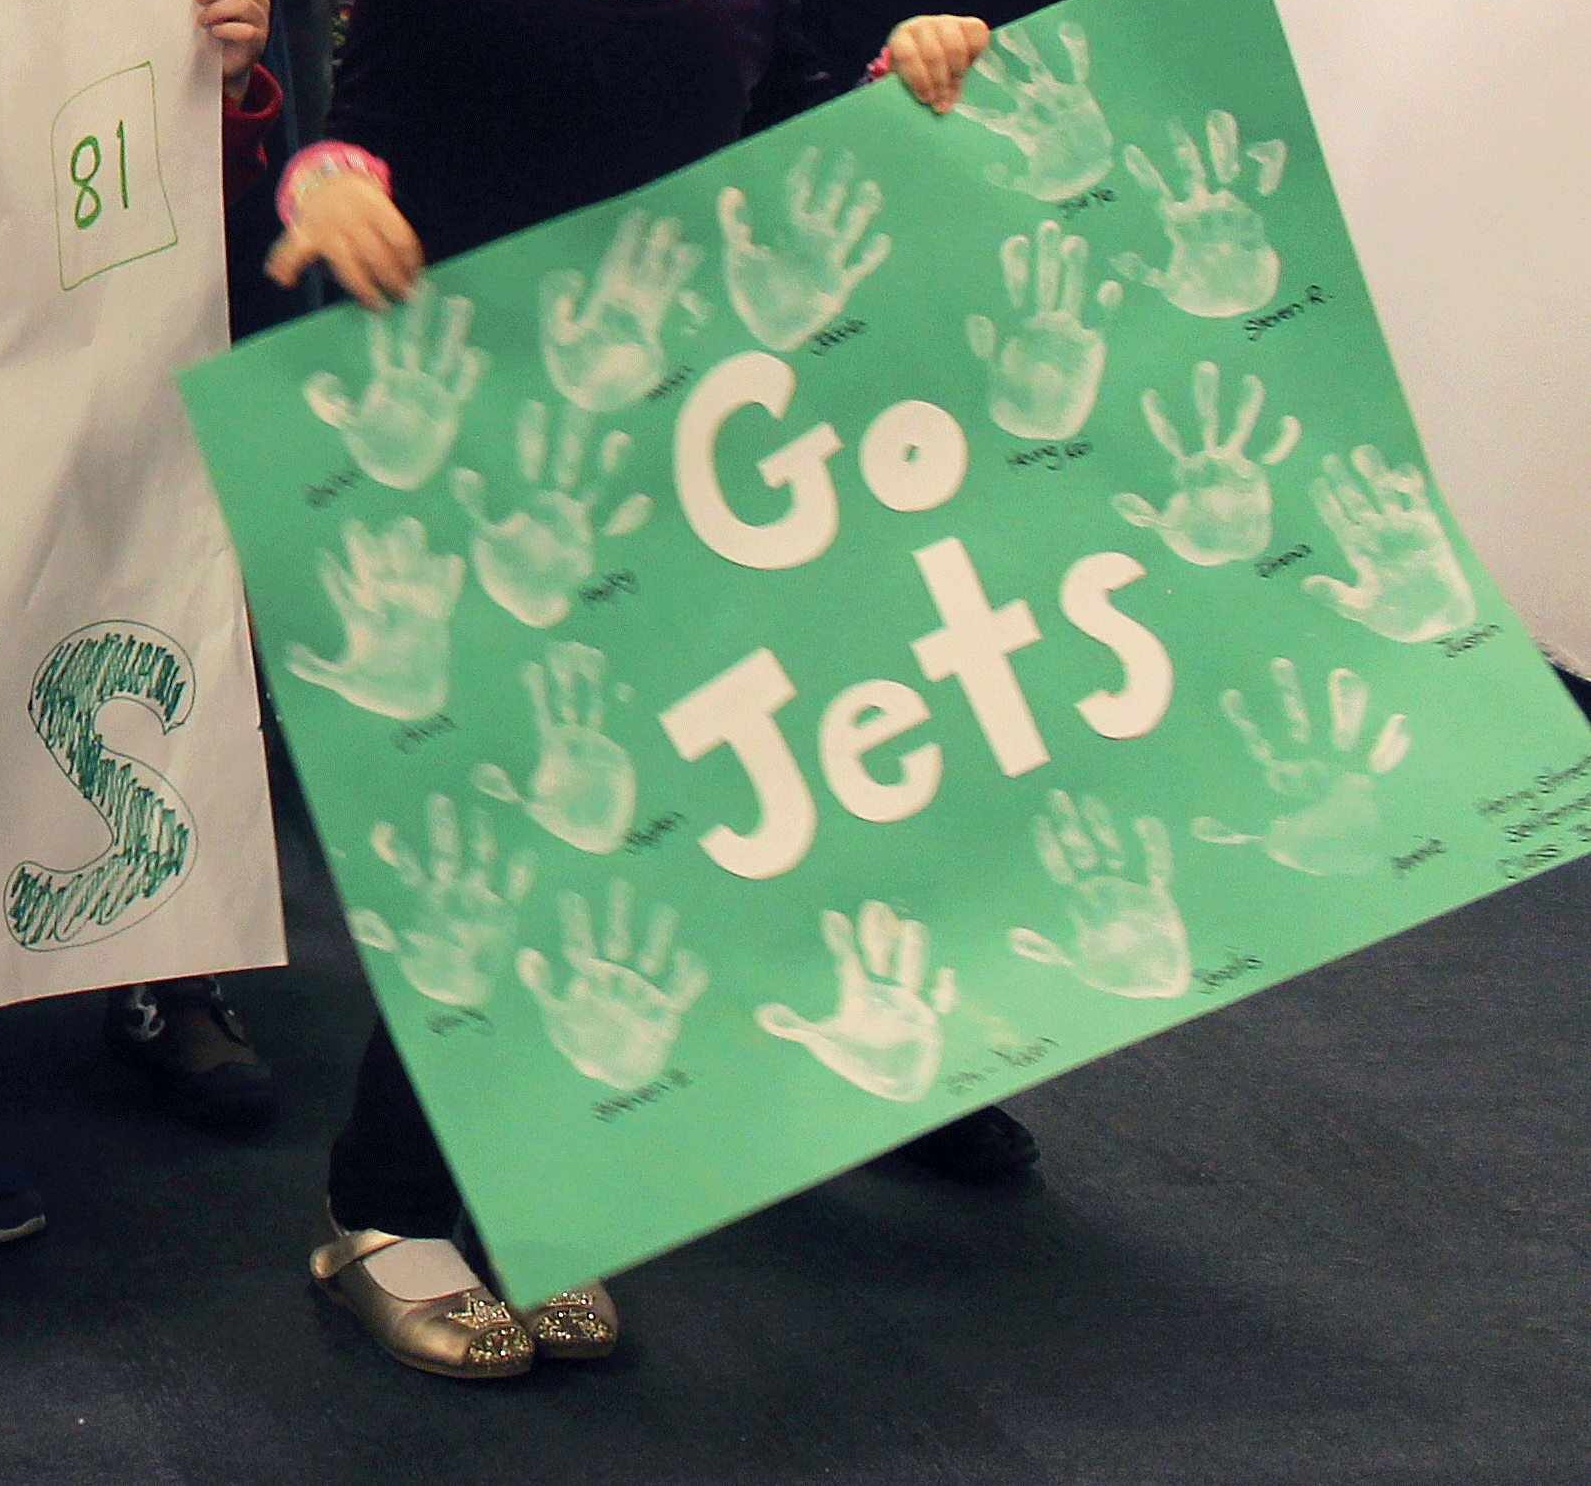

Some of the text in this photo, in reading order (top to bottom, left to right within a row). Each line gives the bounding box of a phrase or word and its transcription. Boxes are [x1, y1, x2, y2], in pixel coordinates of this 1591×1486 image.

[68, 118, 132, 228] 81
[1242, 301, 1305, 342] Steven
[672, 350, 968, 569] Go
[659, 537, 1174, 879] Jets
